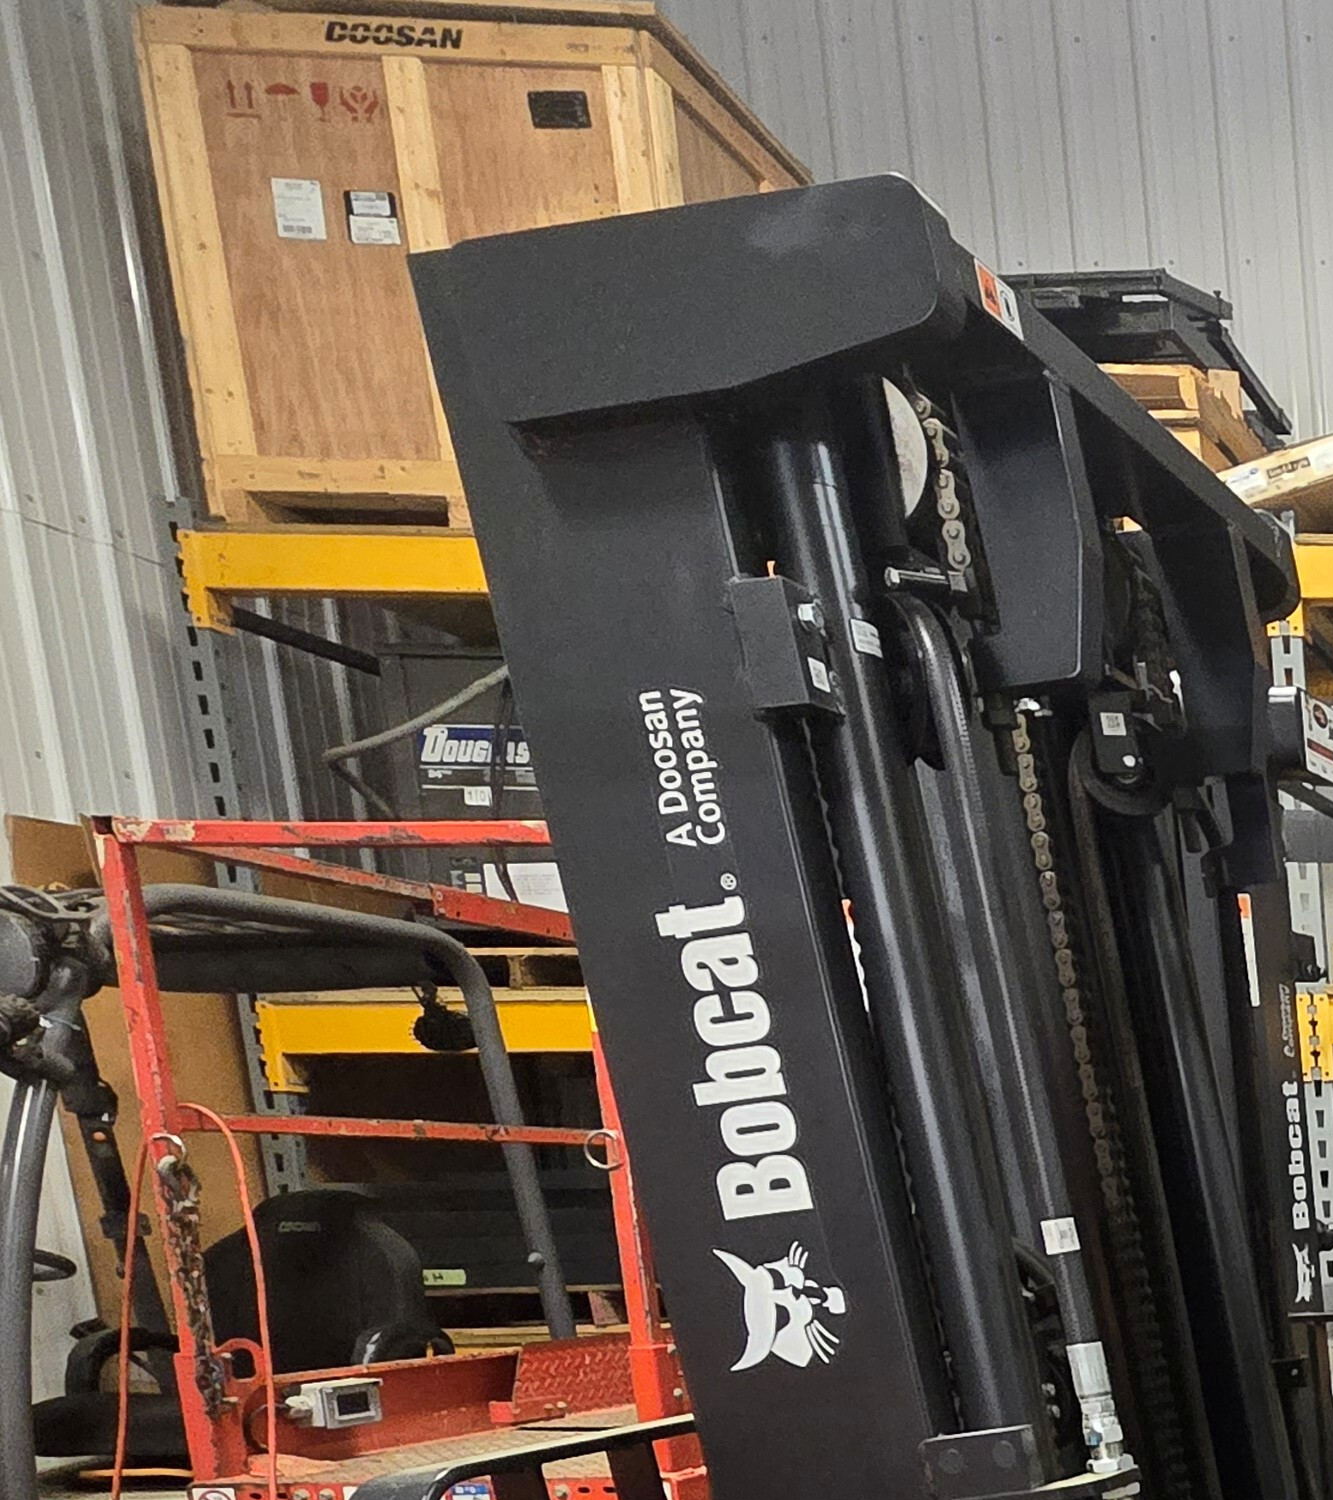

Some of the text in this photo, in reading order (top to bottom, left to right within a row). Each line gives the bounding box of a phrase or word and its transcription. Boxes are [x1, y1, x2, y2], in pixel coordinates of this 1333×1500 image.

[325, 21, 464, 49] DOOSAN
[639, 690, 698, 847] A Doosan
[669, 688, 726, 845] Company
[655, 895, 814, 1221] Bobcat
[1282, 1081, 1310, 1230] Bobcat
